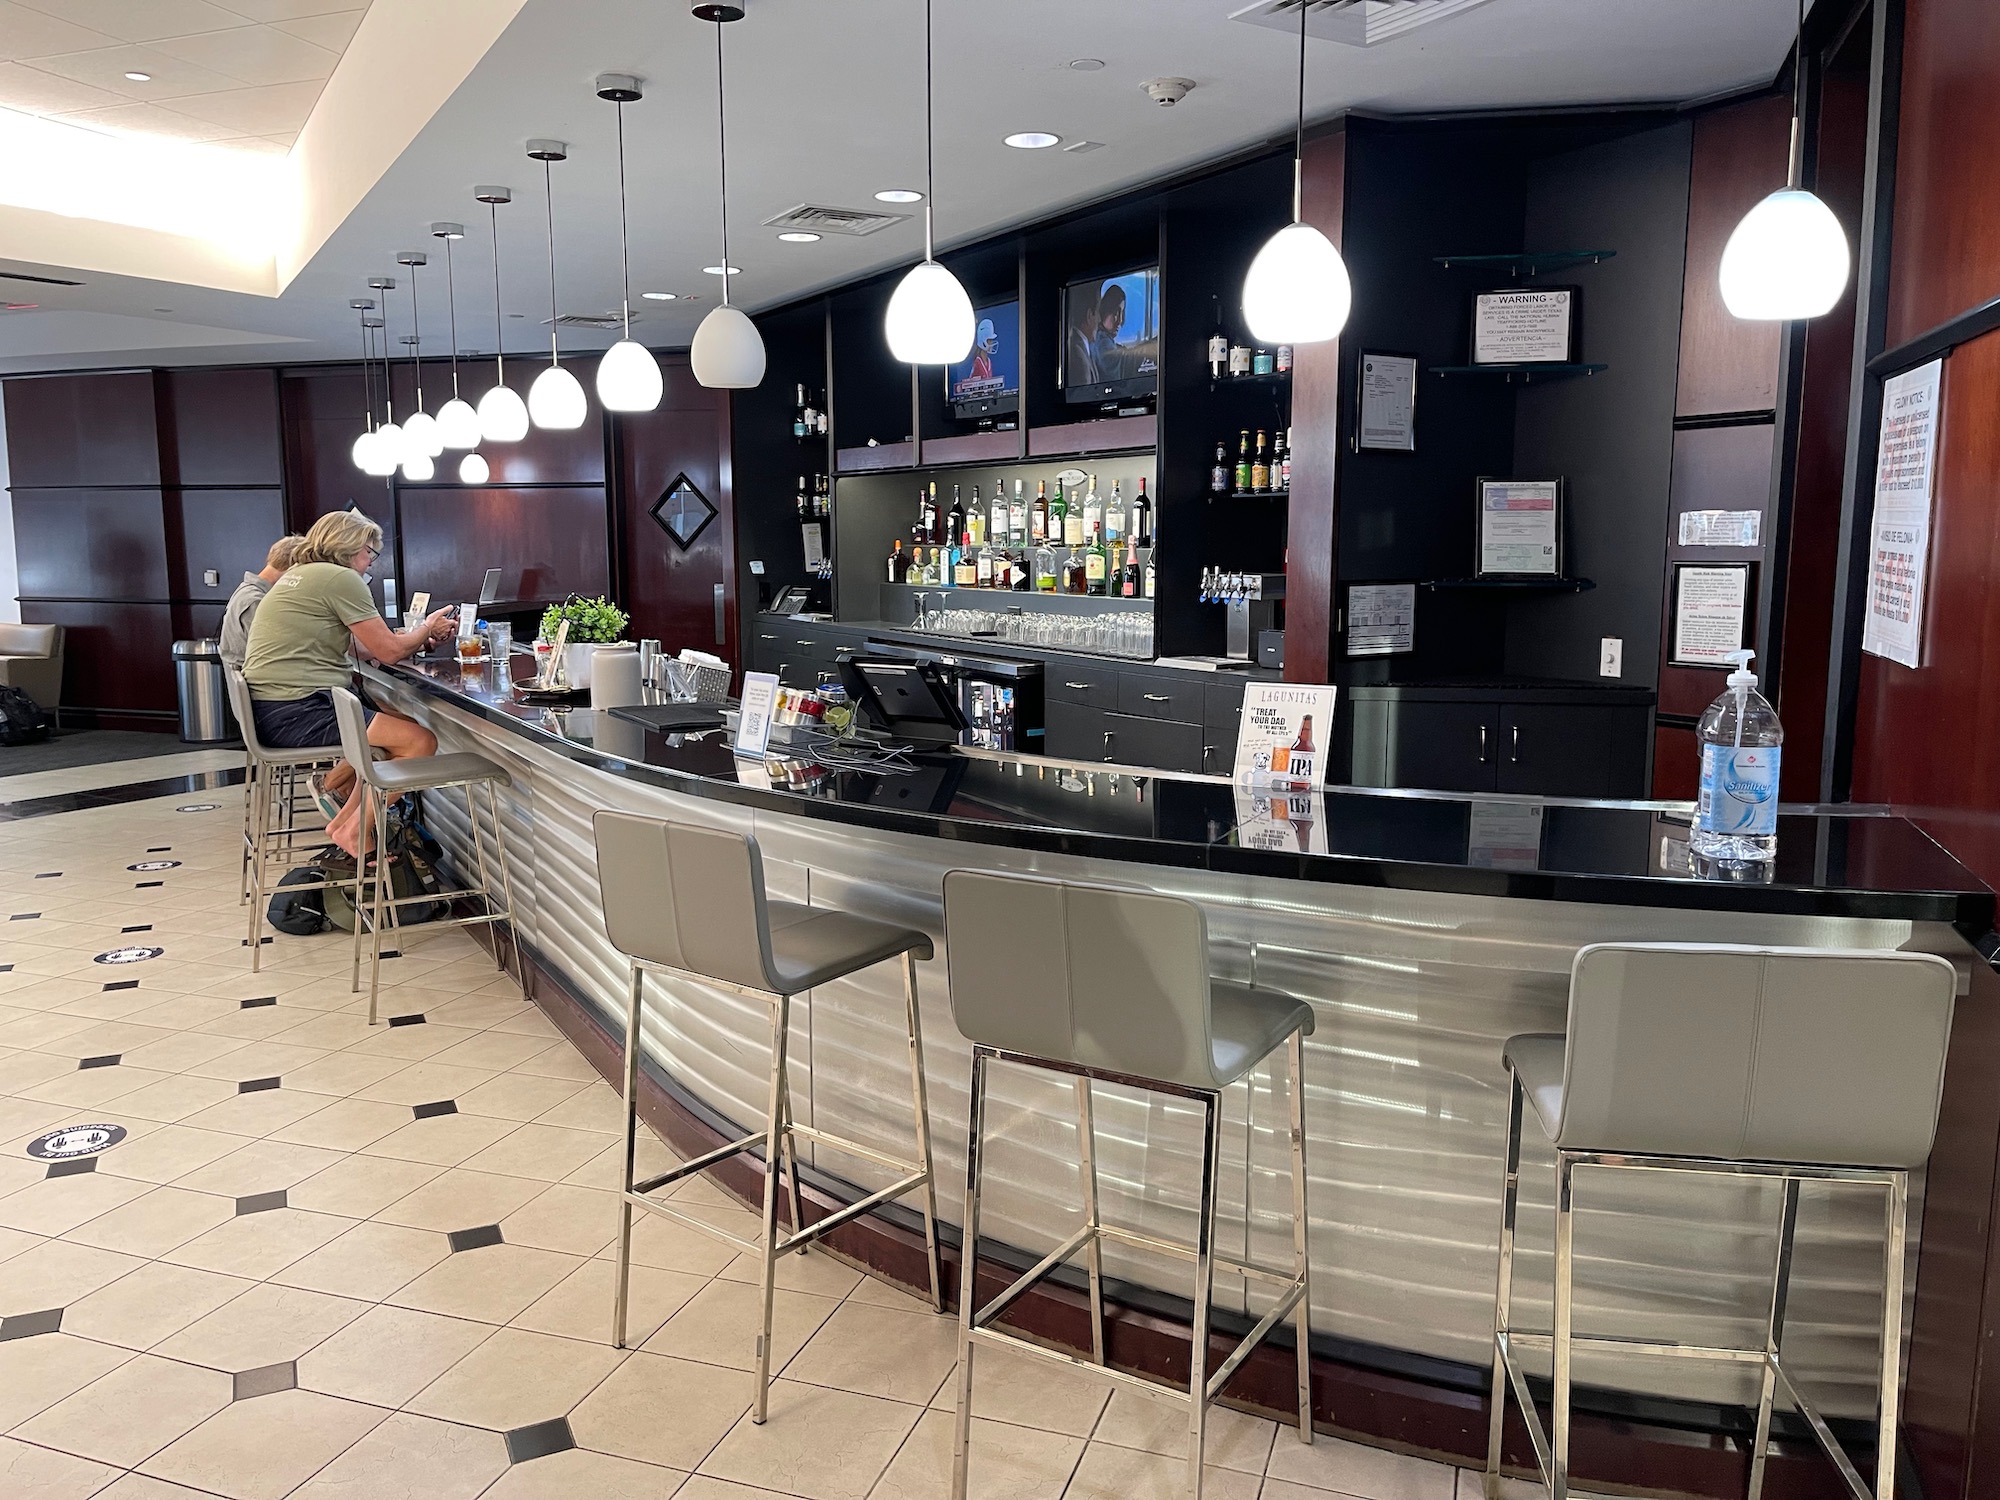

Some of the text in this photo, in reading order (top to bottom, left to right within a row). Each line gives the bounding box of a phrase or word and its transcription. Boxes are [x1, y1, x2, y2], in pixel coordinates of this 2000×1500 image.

[1498, 295, 1546, 304] WARNING
[1261, 691, 1317, 704] LAGUNITAS
[1250, 716, 1269, 724] YOUR
[1290, 758, 1311, 775] IPA
[1728, 781, 1771, 791] Sanitizer
